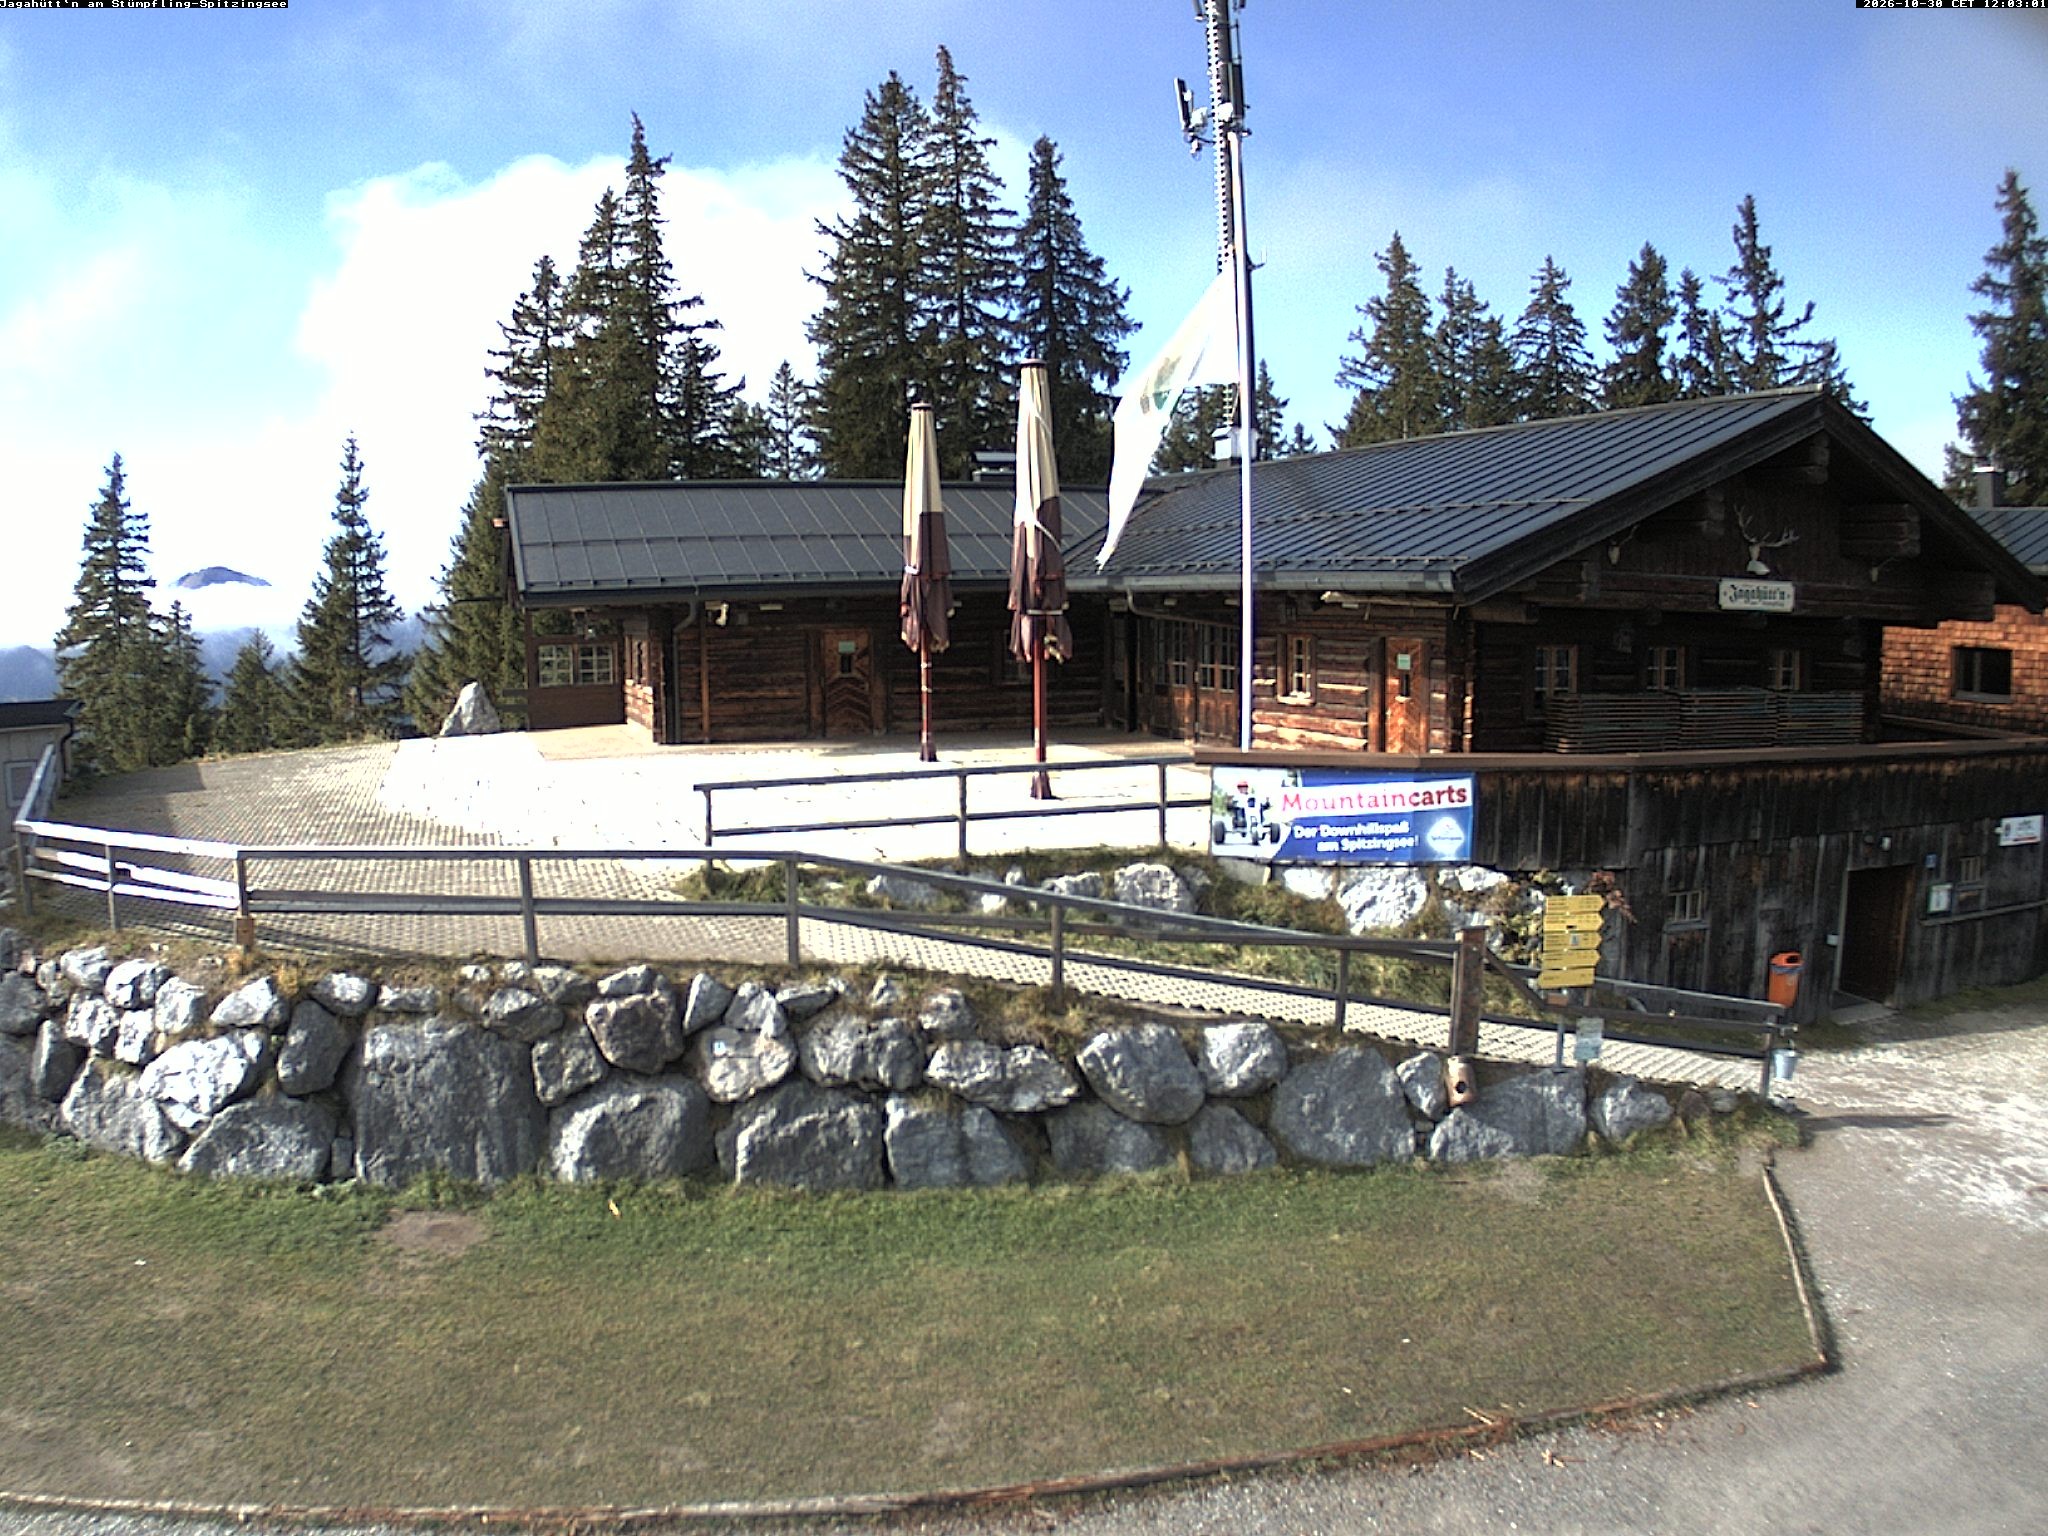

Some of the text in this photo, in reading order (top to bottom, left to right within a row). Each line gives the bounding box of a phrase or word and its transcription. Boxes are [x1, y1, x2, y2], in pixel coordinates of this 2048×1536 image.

[1281, 785, 1468, 812] Mountaincarts
[1293, 820, 1410, 839] Der Downhillspaß
[1316, 841, 1340, 852] am
[1341, 835, 1420, 853] Spitzingsee!
